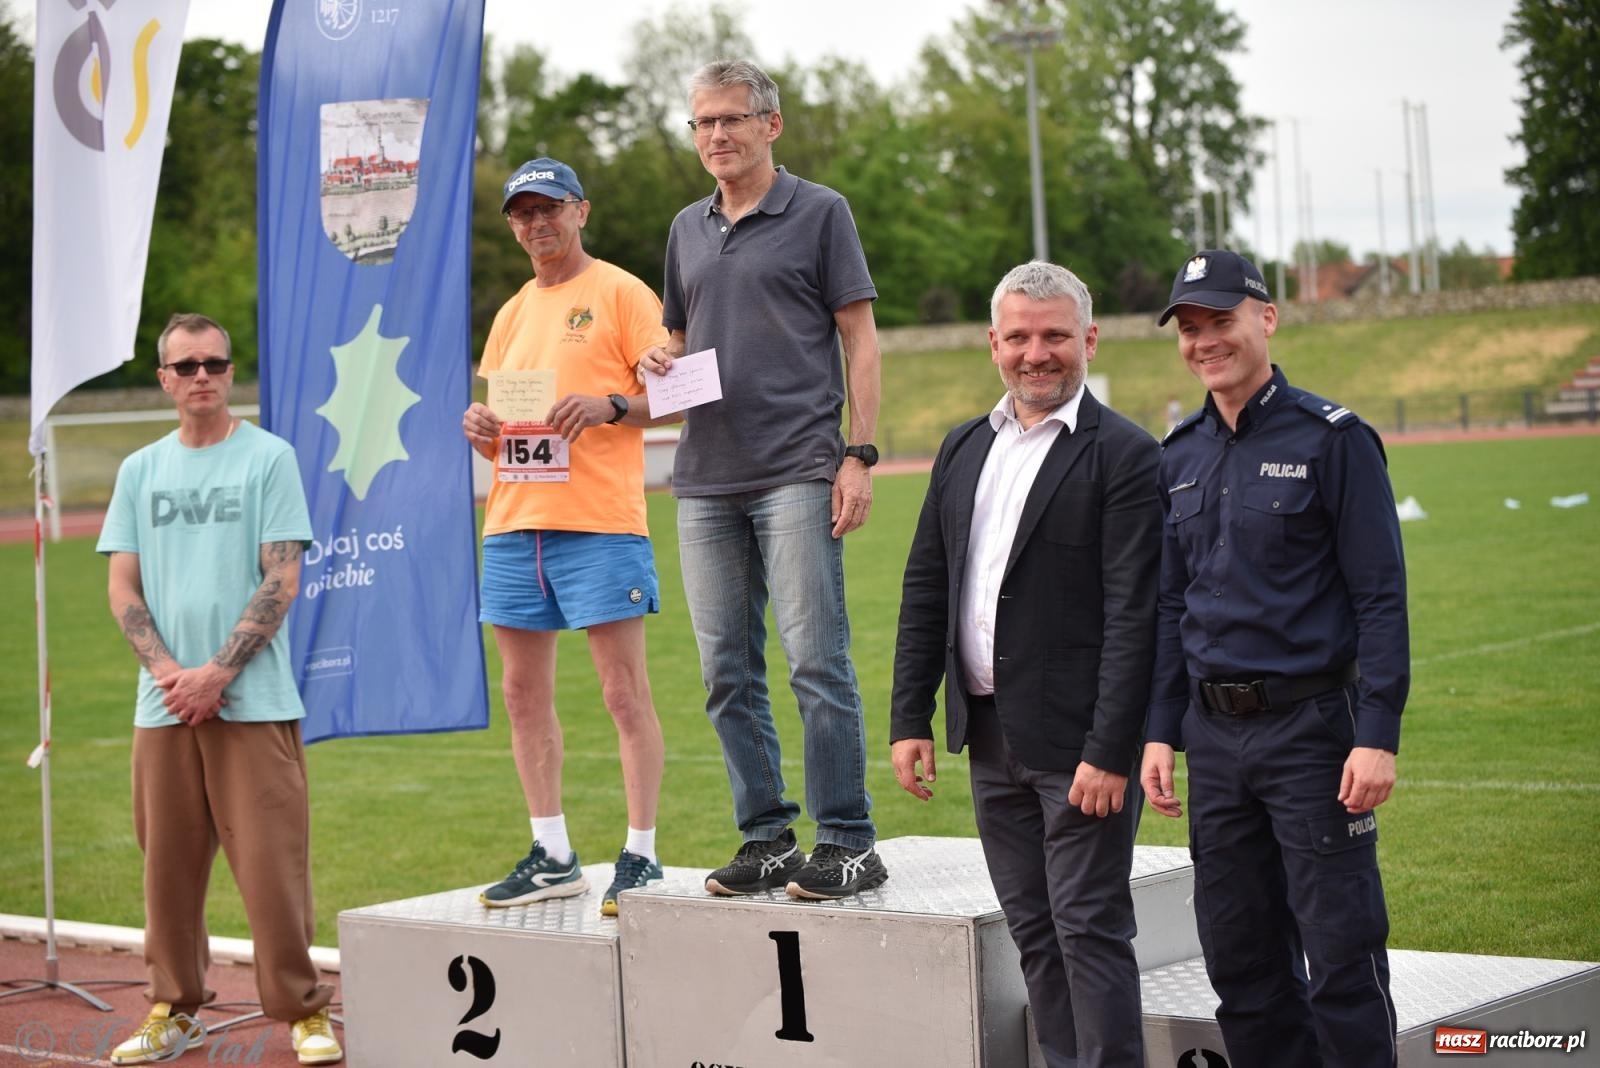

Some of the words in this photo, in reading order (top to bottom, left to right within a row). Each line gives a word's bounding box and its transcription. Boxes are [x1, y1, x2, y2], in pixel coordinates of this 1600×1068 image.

[371, 8, 399, 26] 1217
[508, 170, 555, 192] adidas
[1260, 384, 1278, 406] POLICJA
[506, 438, 553, 465] 154
[1260, 462, 1308, 479] POLICJA
[365, 524, 404, 551] coś
[768, 930, 815, 1043] 1
[447, 953, 502, 1061] 2
